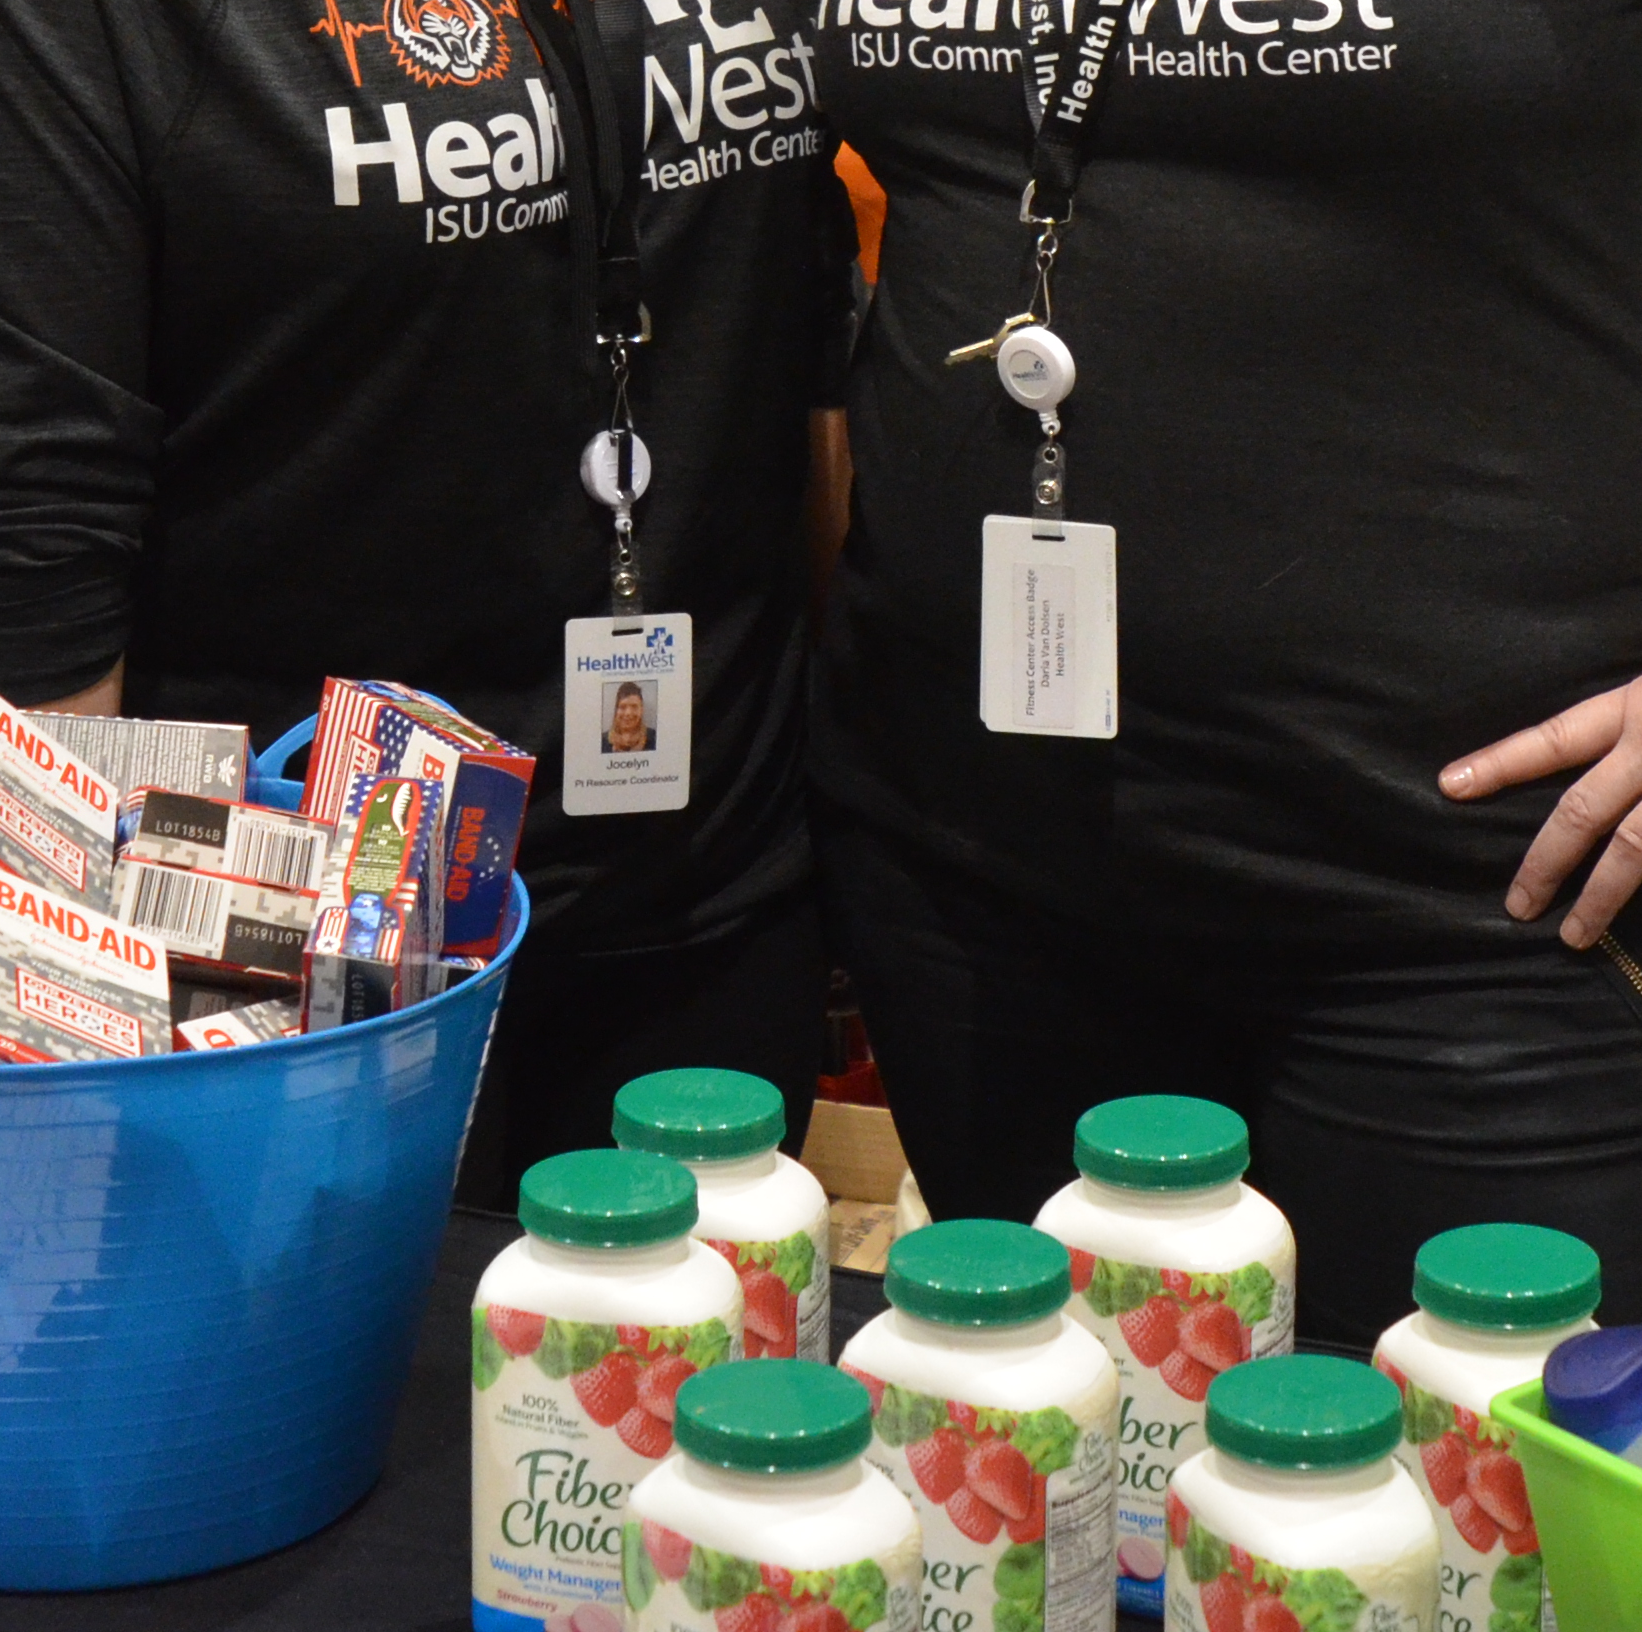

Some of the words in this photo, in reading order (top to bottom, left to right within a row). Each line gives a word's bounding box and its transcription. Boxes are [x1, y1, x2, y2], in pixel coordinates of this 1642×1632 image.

[851, 31, 900, 68] ISU
[1128, 41, 1246, 78] Health
[1258, 39, 1397, 77] Center
[1058, 5, 1119, 124] Health
[325, 78, 567, 207] Healt
[425, 201, 490, 245] ISU
[749, 125, 823, 167] Cente
[1027, 569, 1038, 602] Badge
[1026, 604, 1035, 639] Access
[1041, 599, 1050, 636] Dolsen
[1055, 613, 1065, 640] West
[1026, 643, 1035, 676] Center
[1041, 636, 1050, 655] Van
[1055, 641, 1065, 677] Health
[577, 653, 675, 672] HealthWest
[1041, 655, 1050, 688] Daria
[1026, 680, 1035, 717] Fitness
[606, 758, 649, 771] Jocelyn
[575, 779, 584, 788] Pt
[586, 777, 627, 788] Resource
[630, 775, 679, 786] Coordinator
[155, 820, 222, 842] LOT1854B
[446, 806, 485, 902] BAND-AID
[234, 923, 303, 946] LOT1854B
[24, 988, 135, 1047] HEROES
[502, 1404, 546, 1425] Natural
[547, 1414, 580, 1429] Fiber
[522, 1393, 559, 1412] 100%
[1119, 1396, 1198, 1451] ber
[500, 1499, 622, 1555] Choic
[490, 1553, 544, 1584] Weight
[497, 1589, 558, 1613] Strawberry
